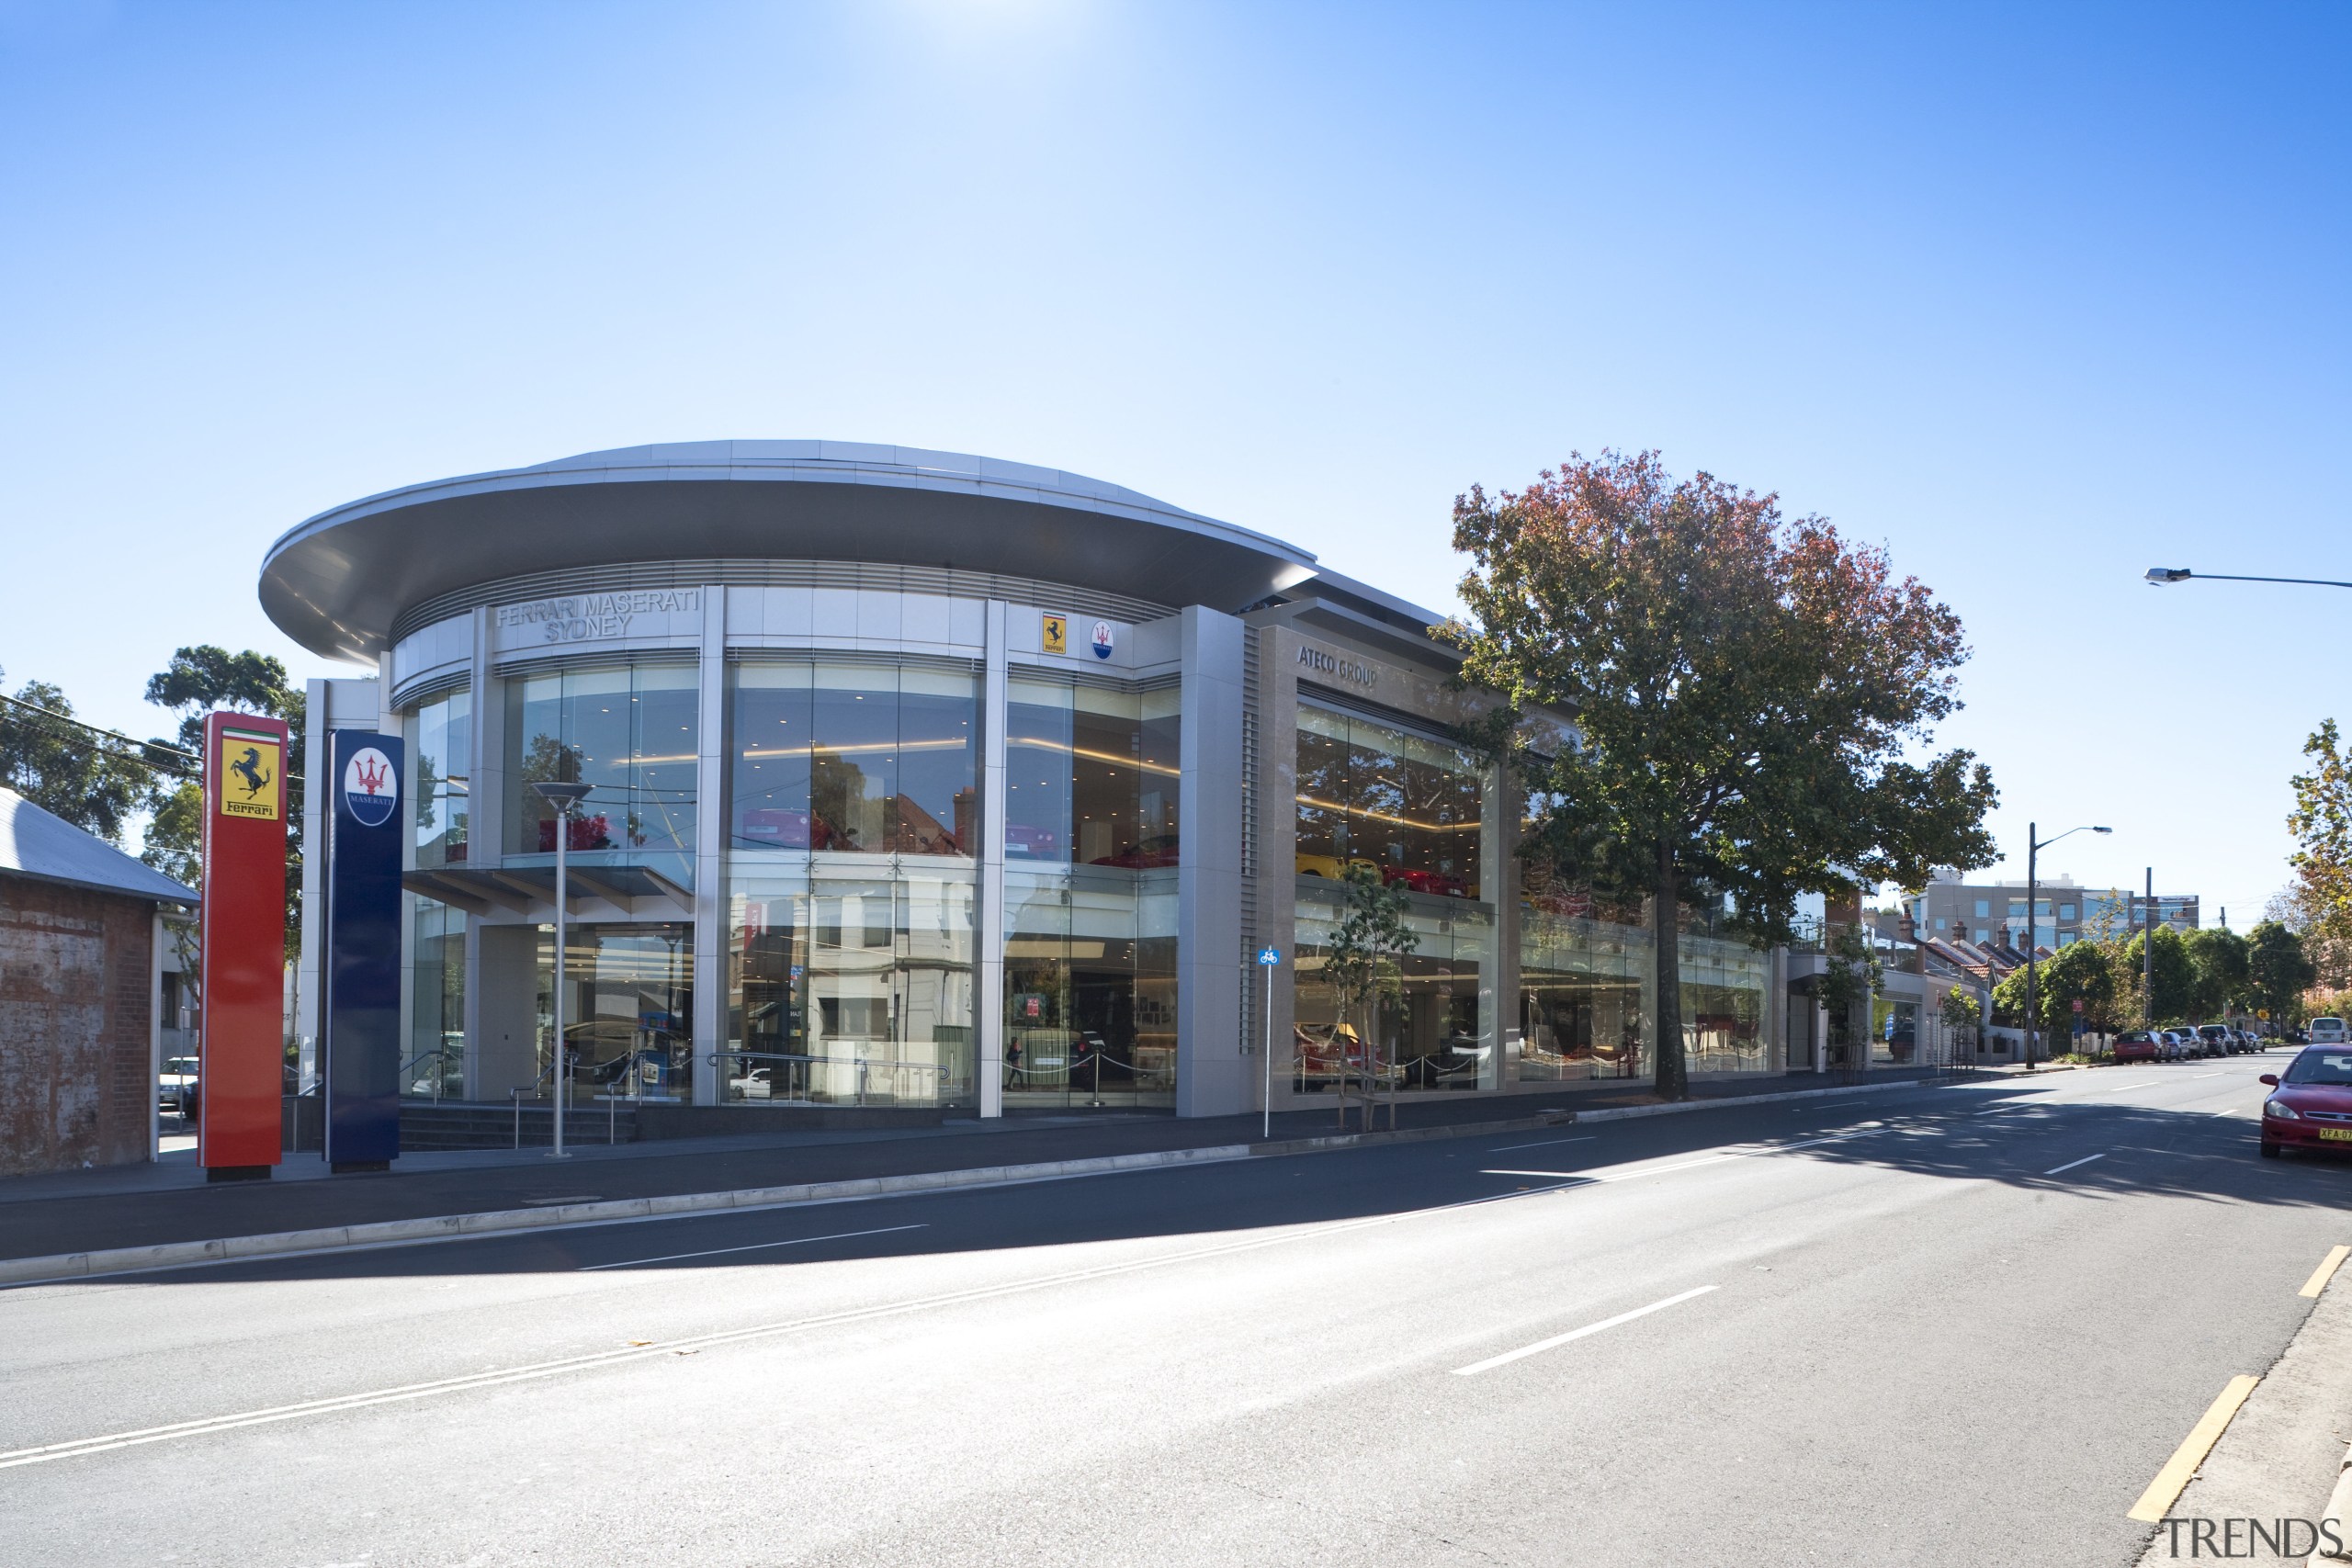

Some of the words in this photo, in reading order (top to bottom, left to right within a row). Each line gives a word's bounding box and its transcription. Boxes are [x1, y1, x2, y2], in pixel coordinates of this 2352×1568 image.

[497, 598, 578, 627] FERRARI
[583, 591, 698, 616] MASERATI
[545, 615, 633, 641] SYDNEY
[1297, 646, 1335, 672] ATECO
[1338, 660, 1377, 686] GROUP
[226, 801, 274, 817] Ferrari
[350, 795, 392, 807] MASERATI
